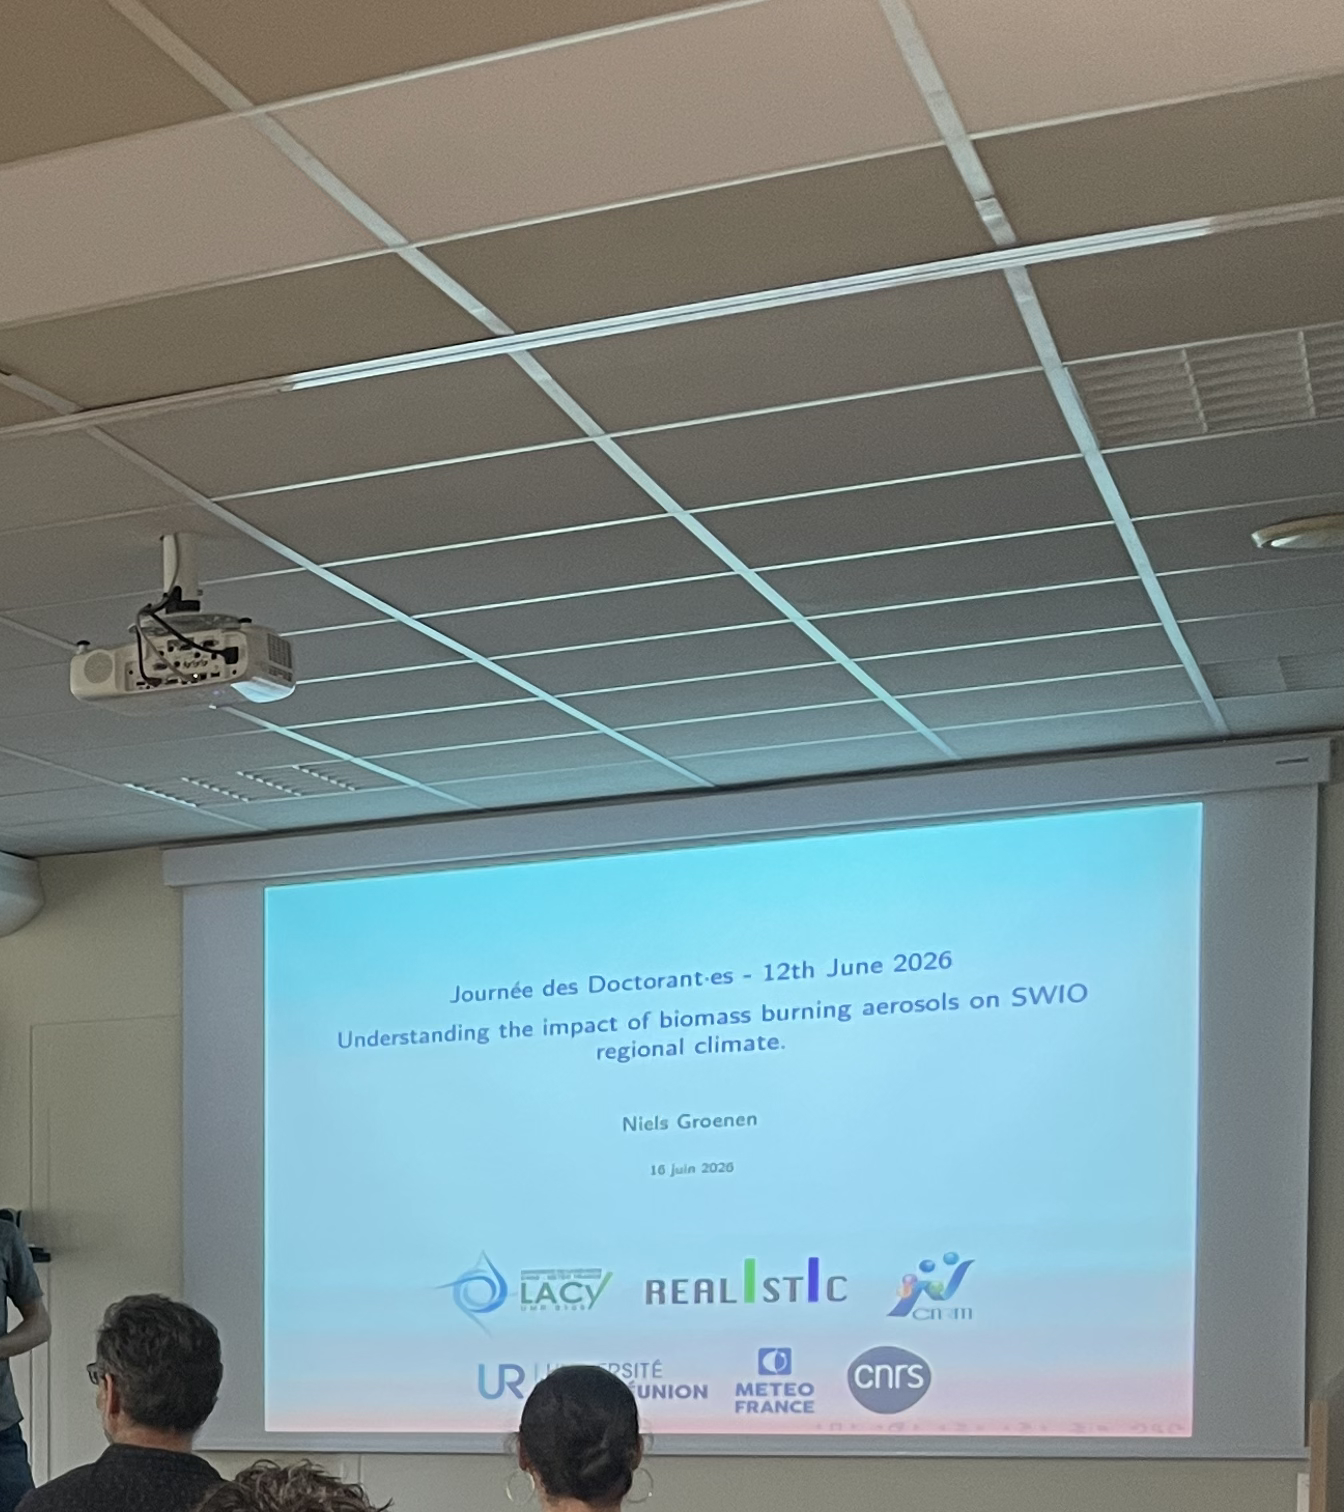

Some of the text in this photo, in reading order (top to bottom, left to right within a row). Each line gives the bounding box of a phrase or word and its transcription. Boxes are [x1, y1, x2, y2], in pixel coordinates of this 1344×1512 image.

[449, 981, 534, 1004] Journée
[542, 978, 579, 998] des
[764, 960, 815, 982] 12th
[827, 957, 884, 979] June
[893, 950, 953, 973] 2026
[337, 983, 1088, 1049] Understanding the impact of biomass burning aerosols on SWIO
[596, 1033, 787, 1063] regional climate.
[622, 1113, 758, 1132] Niels Groenen
[650, 1164, 666, 1176] 16
[670, 1163, 696, 1177] juin
[645, 1256, 849, 1305] REALISTIC
[478, 1363, 526, 1400] UR
[735, 1382, 815, 1397] METEO
[853, 1364, 925, 1390] cnrs
[735, 1400, 816, 1414] FRANCE
